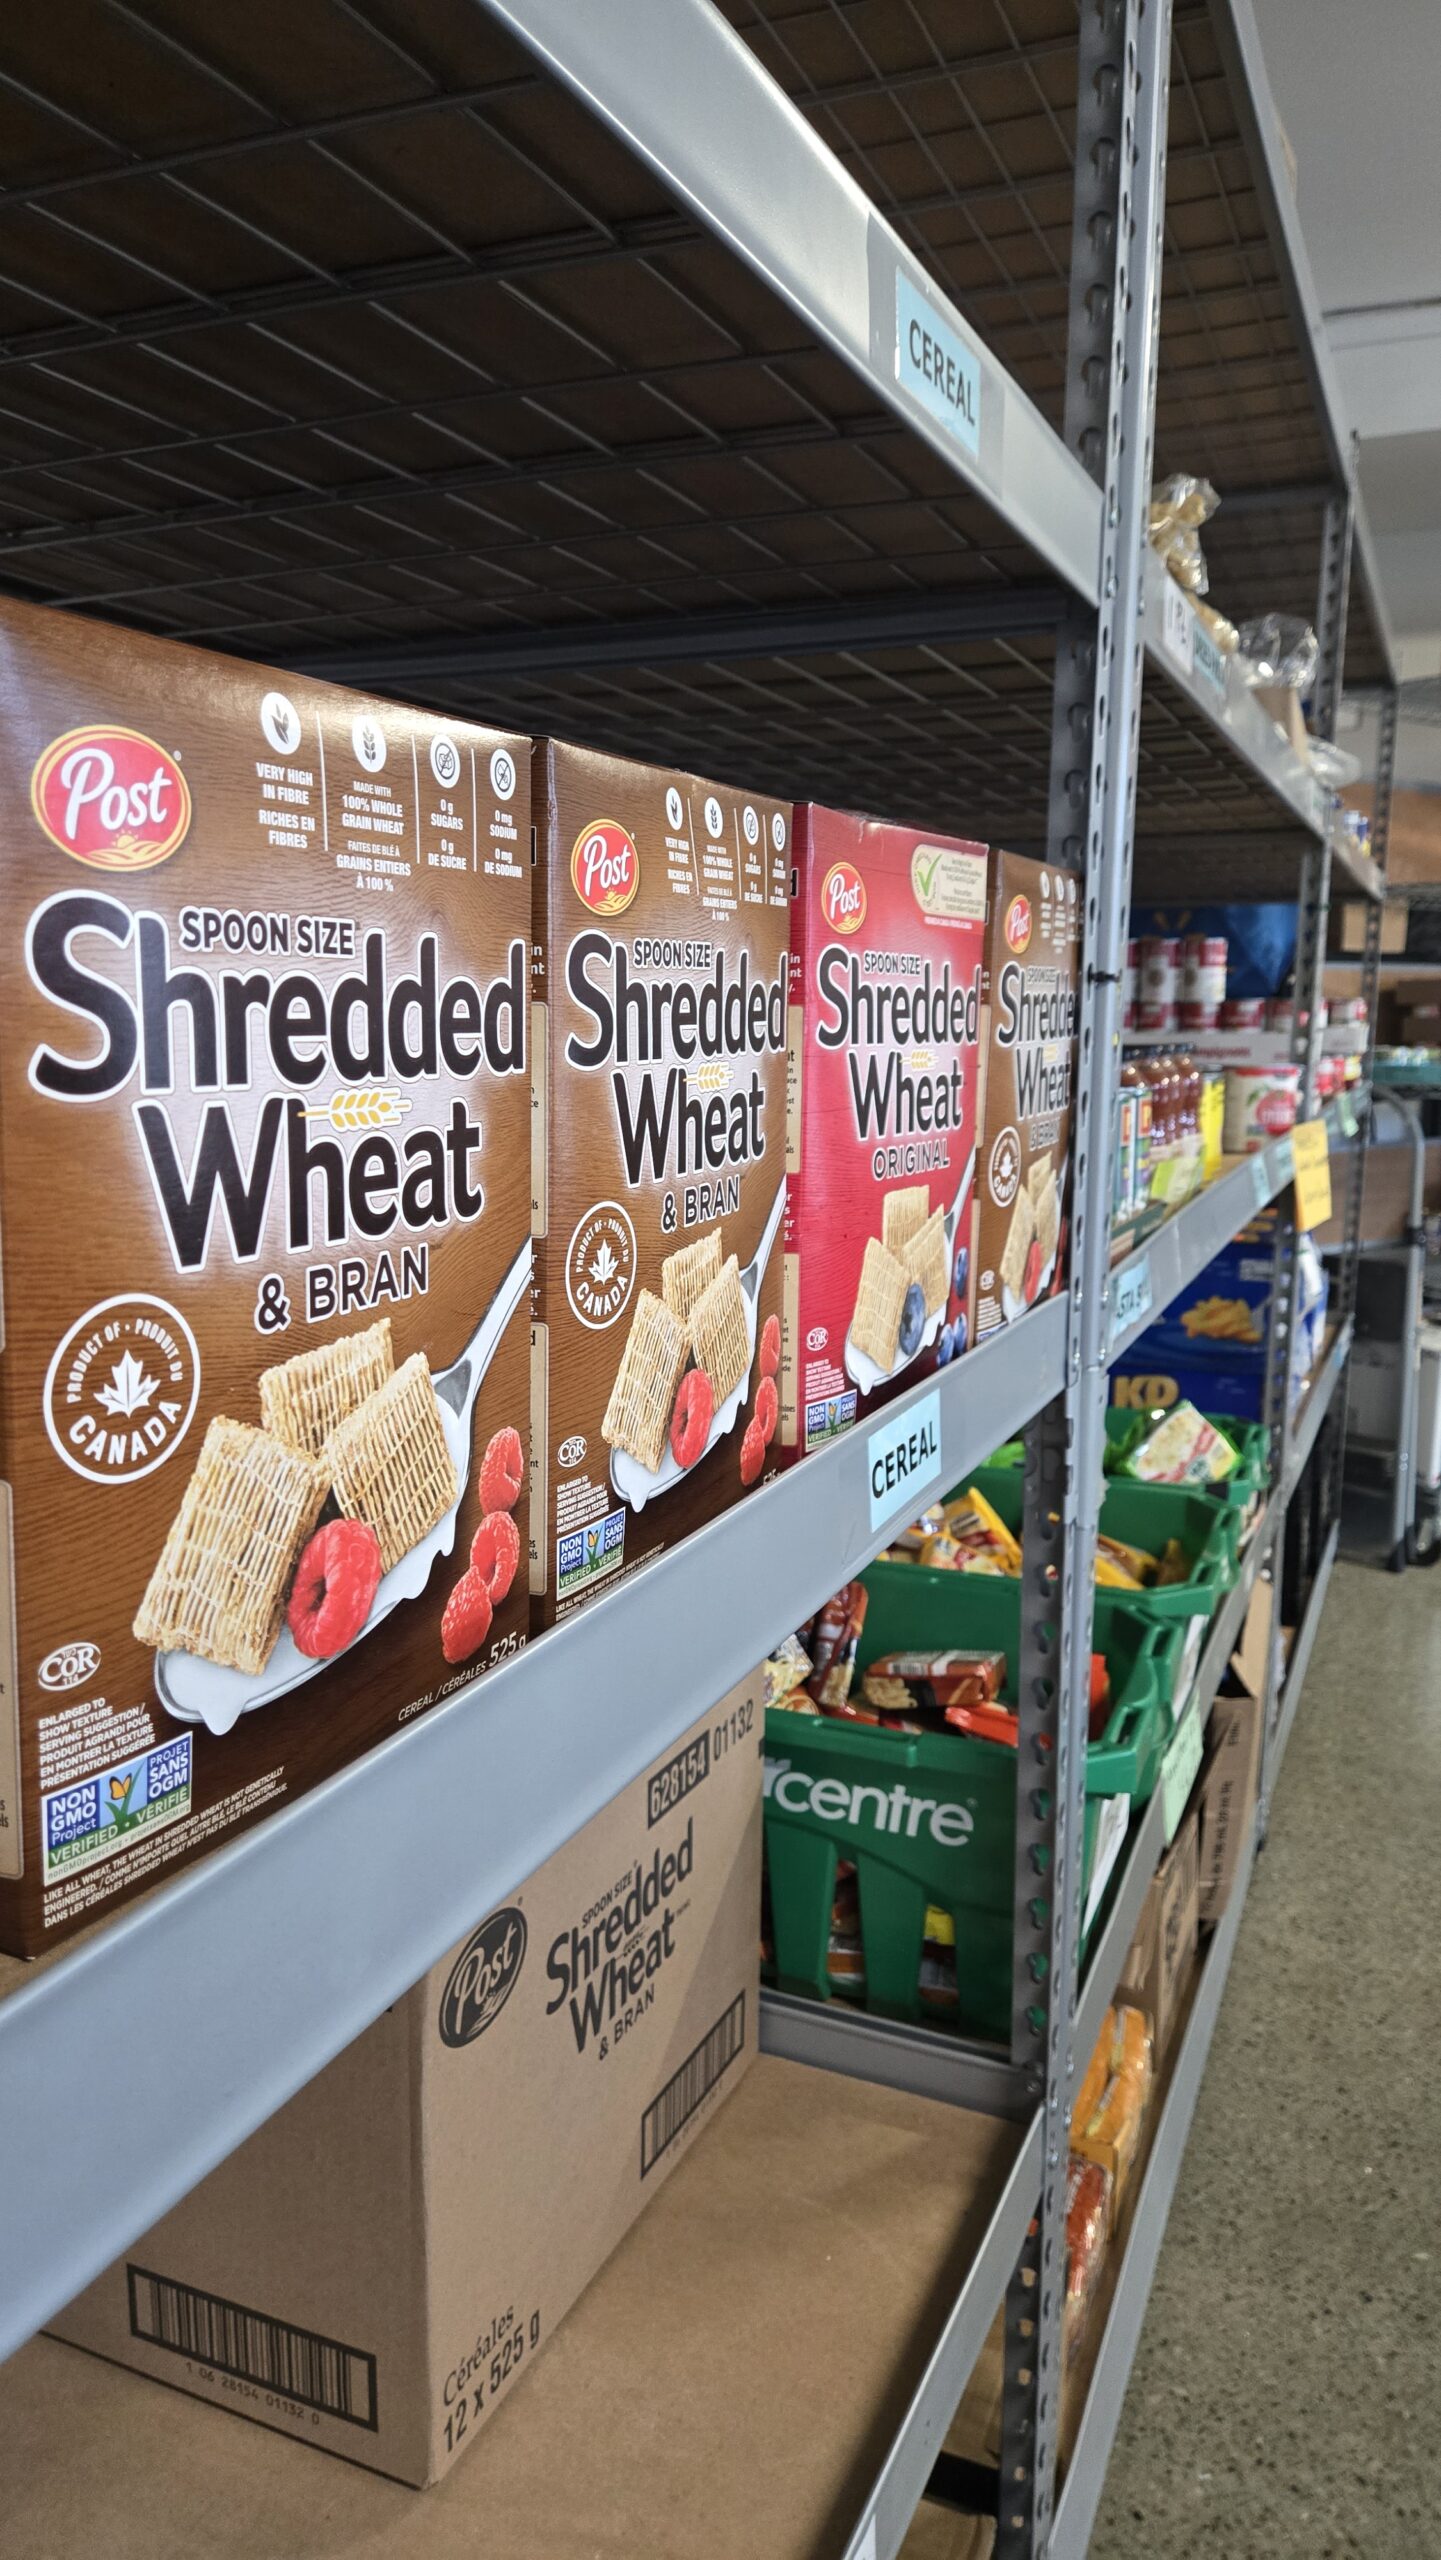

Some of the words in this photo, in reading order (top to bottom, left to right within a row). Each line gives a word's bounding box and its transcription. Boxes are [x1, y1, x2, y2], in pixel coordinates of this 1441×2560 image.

[909, 318, 975, 426] CEREAL
[61, 747, 172, 841] Post
[256, 762, 284, 781] VERY
[287, 769, 313, 786] HIGH
[263, 784, 275, 800] IN
[278, 786, 309, 805] FIBRE
[353, 781, 374, 795] MADE
[374, 785, 391, 797] WITH
[259, 809, 299, 829] RICHES
[301, 816, 315, 831] EN
[342, 795, 370, 812] 100%
[372, 799, 403, 818] WHOLE
[342, 813, 372, 831] GRAIN
[374, 818, 404, 835] WHEAT
[430, 813, 463, 831] SUGARS
[269, 830, 307, 848] FIBRES
[347, 841, 370, 854] FAITES
[372, 844, 381, 855] DE
[382, 844, 394, 857] BLÉ
[489, 824, 518, 840] SODIUM
[336, 854, 372, 873] GRAINS
[373, 859, 411, 876] ENTIERS
[428, 853, 440, 867] DE
[441, 854, 467, 870] SUCRE
[484, 861, 494, 875] DE
[495, 863, 522, 878] SODIUM
[583, 835, 631, 896] Post
[356, 873, 364, 889] À
[366, 876, 384, 891] 100
[384, 878, 394, 892] %
[830, 873, 861, 919] Post
[181, 907, 289, 952] SPOON
[297, 917, 355, 957] SIZE
[634, 938, 682, 968] SPOON
[684, 941, 711, 968] SIZE
[864, 952, 899, 974] SPOON
[900, 955, 921, 976] SIZE
[27, 891, 526, 1100] Shredded
[566, 929, 788, 1070] Shredded
[816, 944, 981, 1049] Shredded
[847, 1050, 964, 1141] Wheat
[1014, 1047, 1071, 1121] Wheat
[611, 1066, 766, 1188] Wheat
[873, 1139, 950, 1181] ORIGINAL
[134, 1092, 484, 1272] Wheat
[662, 1191, 677, 1234] &
[684, 1174, 739, 1227] BRAN
[576, 1225, 595, 1273] PRODUCT
[255, 1274, 289, 1333] &
[306, 1245, 428, 1323] BRAN
[576, 1275, 628, 1316] CANADA
[135, 1318, 180, 1360] PRODUIT
[66, 1333, 104, 1403] PRODUCT
[104, 1321, 120, 1342] OF
[809, 1405, 824, 1417] NON
[69, 1401, 182, 1464] CANADA
[872, 1421, 937, 1499] CEREAL
[561, 1535, 582, 1553] NON
[604, 1533, 623, 1550] OGM
[605, 1521, 623, 1539] SANS
[560, 1558, 582, 1573] Project
[561, 1547, 582, 1564] GMO
[560, 1565, 592, 1588] VERIFIED
[398, 1691, 434, 1722] CEREAL
[434, 1685, 442, 1702] /
[442, 1660, 487, 1695] CÉRÉALES
[489, 1631, 517, 1667] 525
[39, 1703, 92, 1729] ENLARGED
[92, 1697, 106, 1709] TO
[39, 1722, 70, 1740] SHOW
[71, 1705, 113, 1730] TEXTURE
[39, 1730, 82, 1753] SERVING
[82, 1706, 139, 1737] SUGGESTION
[140, 1702, 146, 1715] /
[39, 1741, 83, 1766] PRODUIT
[84, 1725, 125, 1749] AGRANDI
[126, 1713, 151, 1731] POUR
[40, 1765, 55, 1778] EN
[55, 1746, 102, 1771] MONTRER
[102, 1741, 115, 1753] LA
[115, 1723, 154, 1747] TEXTURE
[150, 1741, 188, 1768] PROJET
[651, 1740, 706, 1819] 628154
[713, 1698, 754, 1762] 01132
[40, 1753, 111, 1790] PRÉSENTATION
[111, 1733, 156, 1761] SUGGÉRÉE
[150, 1752, 188, 1783] SANS
[52, 1785, 96, 1816] NON
[149, 1769, 187, 1799] OGM
[51, 1802, 97, 1832] GMO
[52, 1818, 97, 1846] Project
[51, 1824, 118, 1864] VERIFIED
[44, 1887, 63, 1903] LIKE
[65, 1879, 81, 1897] ALL
[81, 1864, 111, 1885] WHEAT,
[112, 1855, 127, 1870] THE
[128, 1840, 154, 1861] WHEAT
[44, 1883, 97, 1916] ENGINEERED.
[44, 1908, 69, 1928] DANS
[69, 1902, 84, 1916] LES
[546, 1816, 693, 2015] Shredded
[582, 1889, 613, 1929] SPOON
[614, 1870, 632, 1898] SIZE
[454, 1922, 517, 2034] Post
[569, 1907, 675, 2053] Wheat
[598, 2028, 609, 2061] &
[614, 1982, 656, 2046] BRAN
[444, 2305, 514, 2407] Céréales
[222, 2376, 258, 2400] 28154
[266, 2394, 304, 2419] 01132
[444, 2398, 467, 2453] 12
[474, 2381, 484, 2418] x
[490, 2322, 523, 2394] 525
[530, 2309, 540, 2350] g
